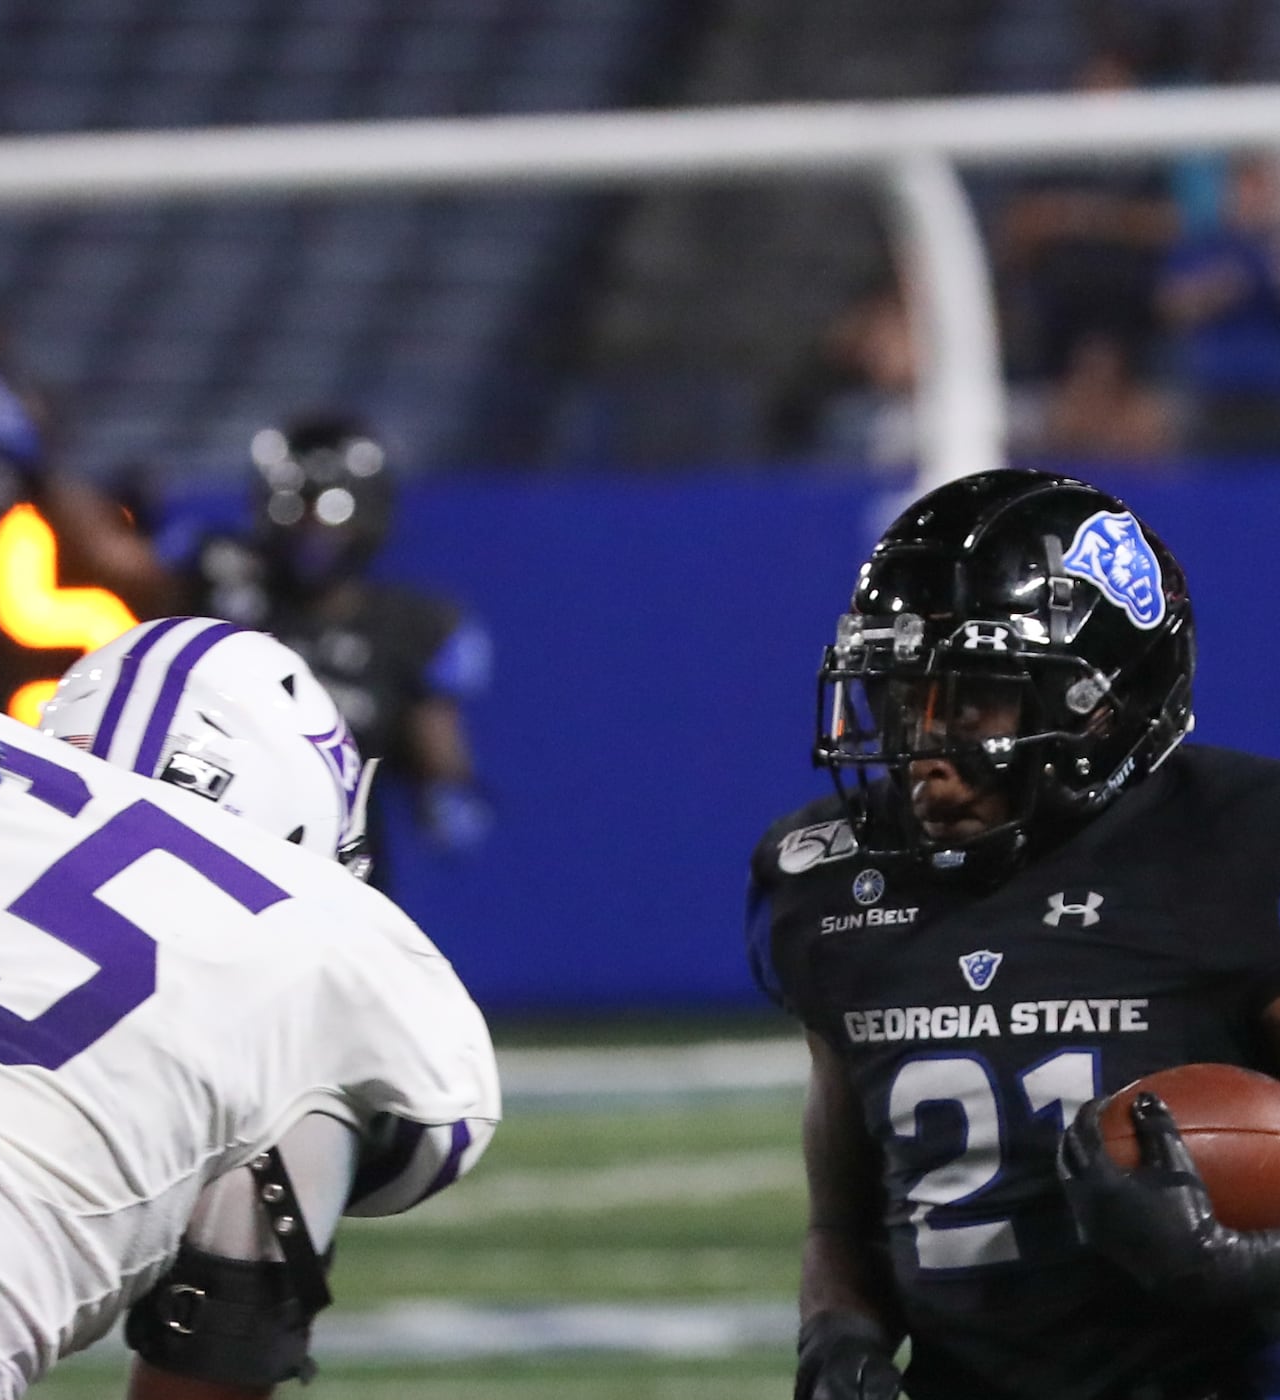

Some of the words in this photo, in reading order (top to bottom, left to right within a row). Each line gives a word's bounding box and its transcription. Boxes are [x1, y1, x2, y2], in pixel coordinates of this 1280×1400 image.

[821, 912, 863, 934] SUN
[866, 907, 919, 926] BELT
[843, 1004, 1001, 1043] GEORGIA
[1009, 999, 1149, 1035] STATE
